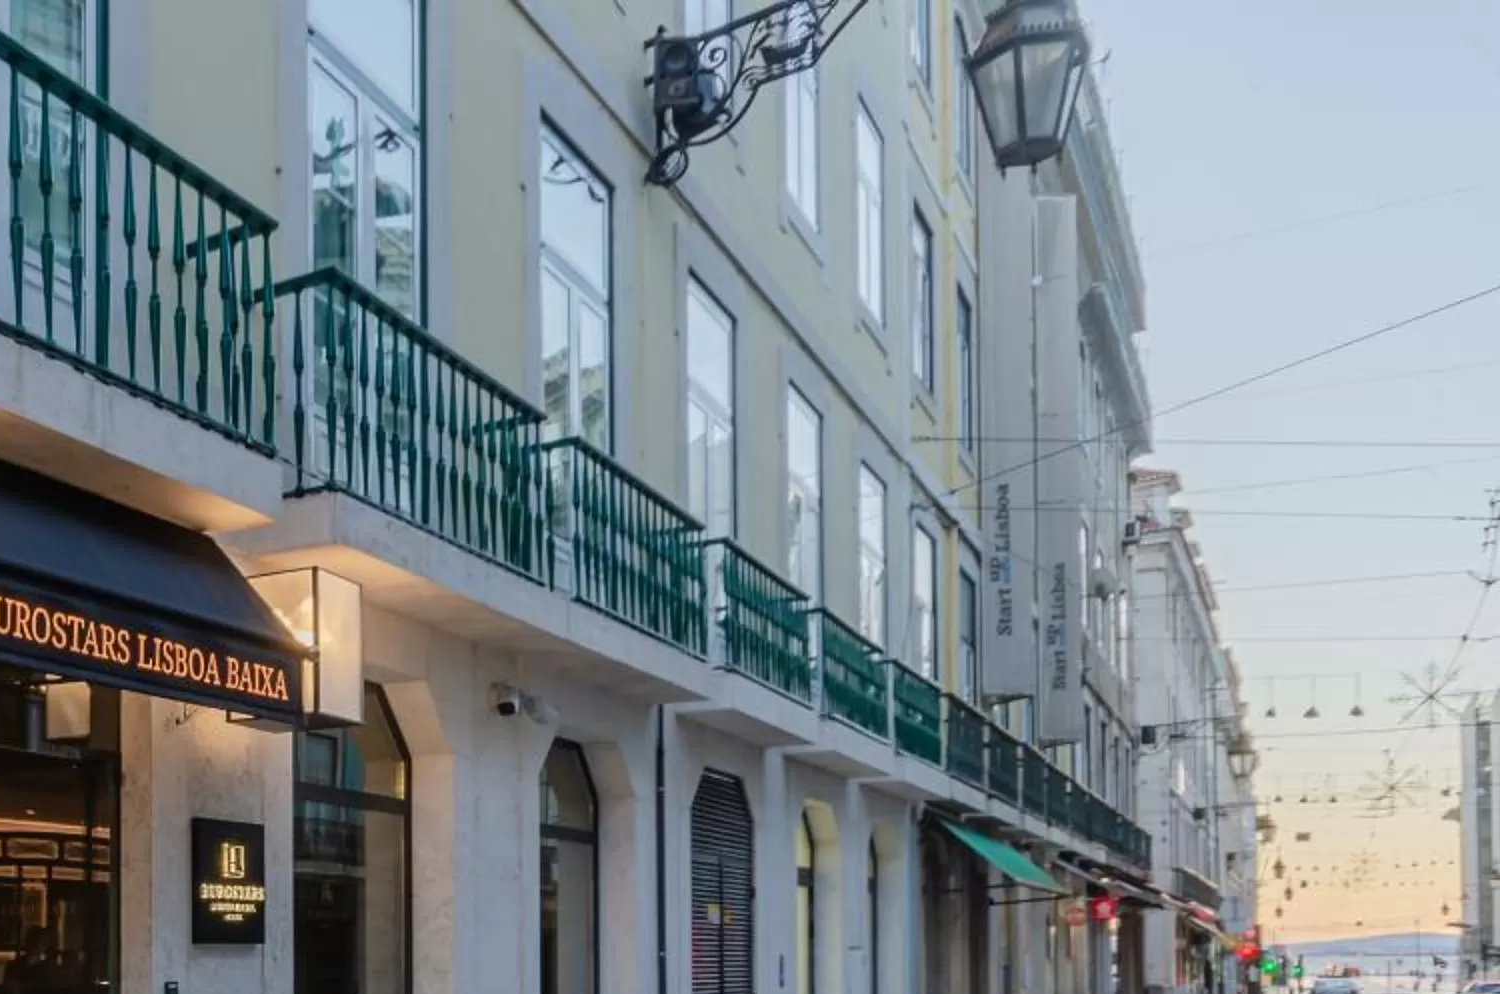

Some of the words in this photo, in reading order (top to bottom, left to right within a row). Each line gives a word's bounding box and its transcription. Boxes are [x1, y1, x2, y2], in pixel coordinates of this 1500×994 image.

[994, 483, 1011, 553] Lisboa
[996, 587, 1013, 637] Start
[1049, 562, 1066, 620] Lisboa
[136, 634, 220, 685] LISBOA
[225, 656, 289, 701] BAIXA
[1051, 650, 1067, 691] Start
